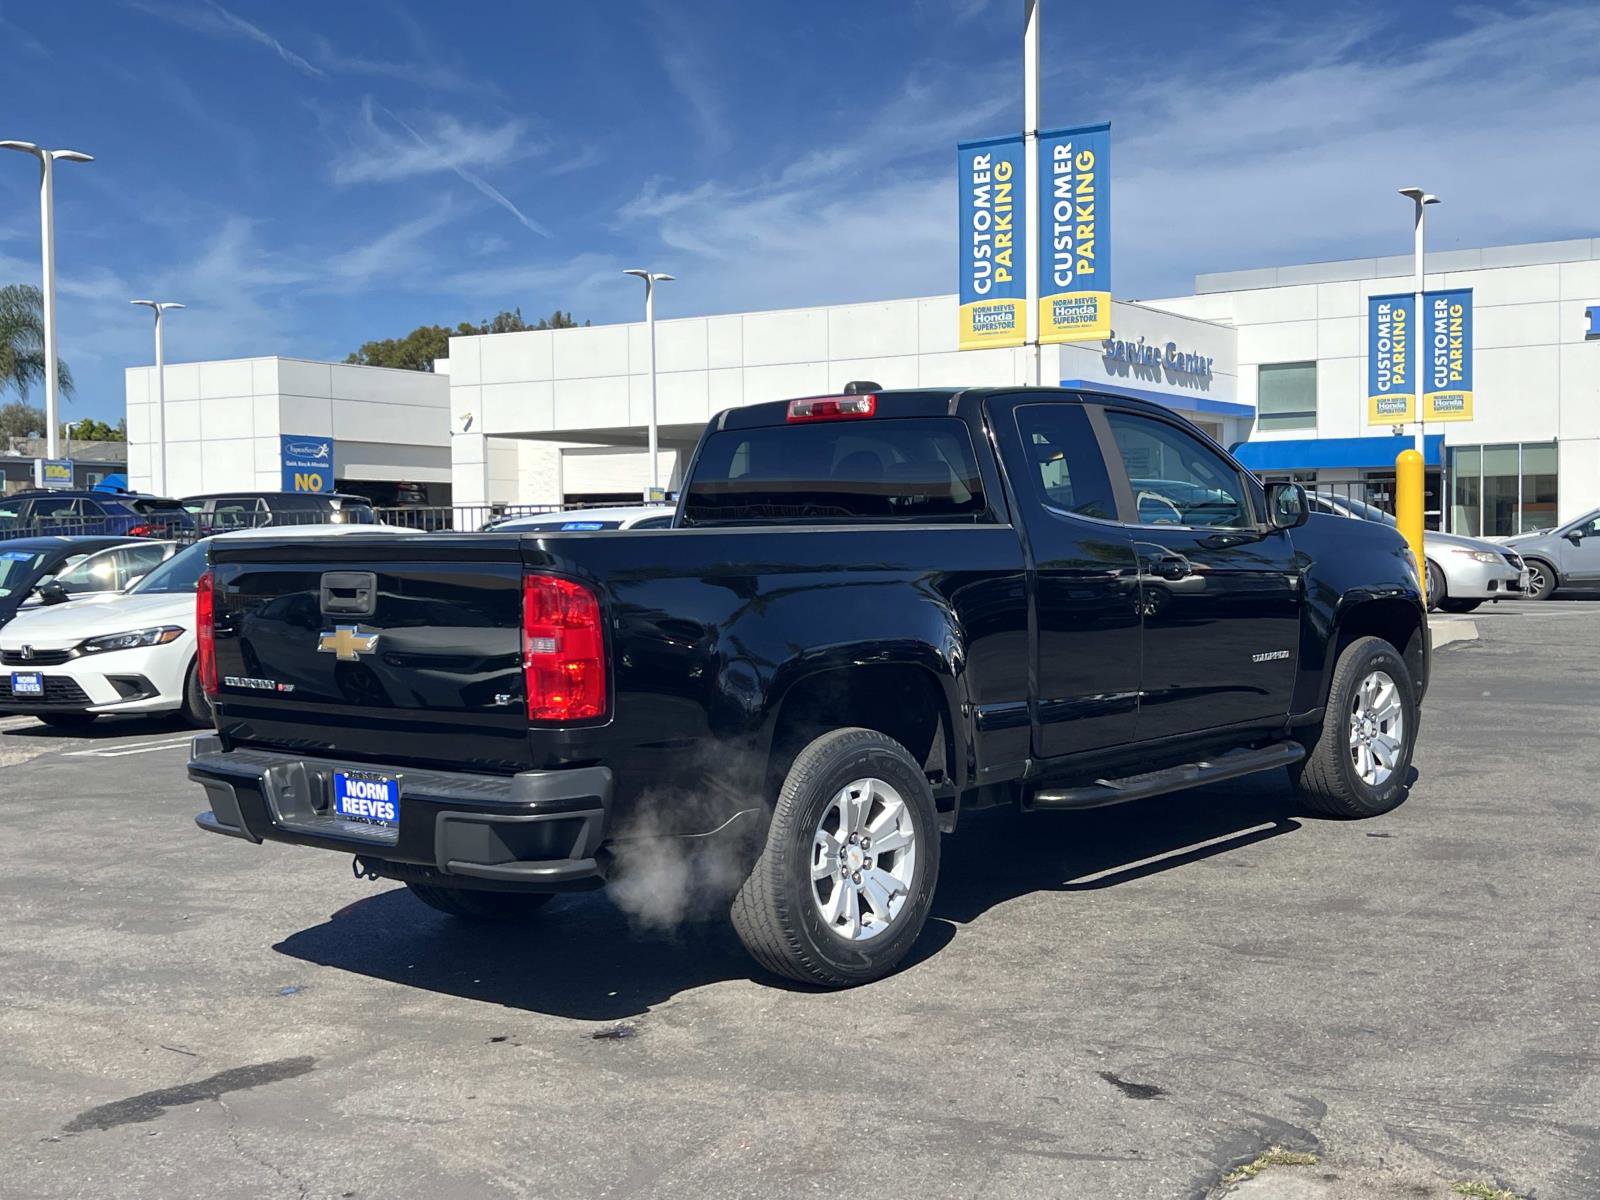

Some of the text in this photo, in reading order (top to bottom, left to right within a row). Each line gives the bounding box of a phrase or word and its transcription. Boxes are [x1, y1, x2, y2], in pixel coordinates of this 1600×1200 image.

[973, 153, 991, 295] CUSTOMER
[994, 161, 1013, 283] PARKING
[1054, 142, 1073, 287] CUSTOMER
[1075, 150, 1095, 275] PARKING
[975, 312, 1013, 323] Honda
[1053, 314, 1097, 325] SUPERSTORE
[1055, 306, 1095, 316] Honda
[973, 321, 1015, 331] SUPERSTORE
[1102, 329, 1213, 376] Service Center
[1378, 303, 1391, 391] CUSTOMER
[1393, 308, 1406, 384] PARKING
[1434, 298, 1448, 388] CUSTOMER
[1450, 304, 1463, 381] PARKING
[1379, 401, 1405, 409] Honda
[1435, 399, 1463, 407] Honda
[295, 473, 323, 492] NO
[15, 683, 41, 692] REEVES
[345, 780, 389, 801] NORM
[341, 796, 395, 820] REEVES
